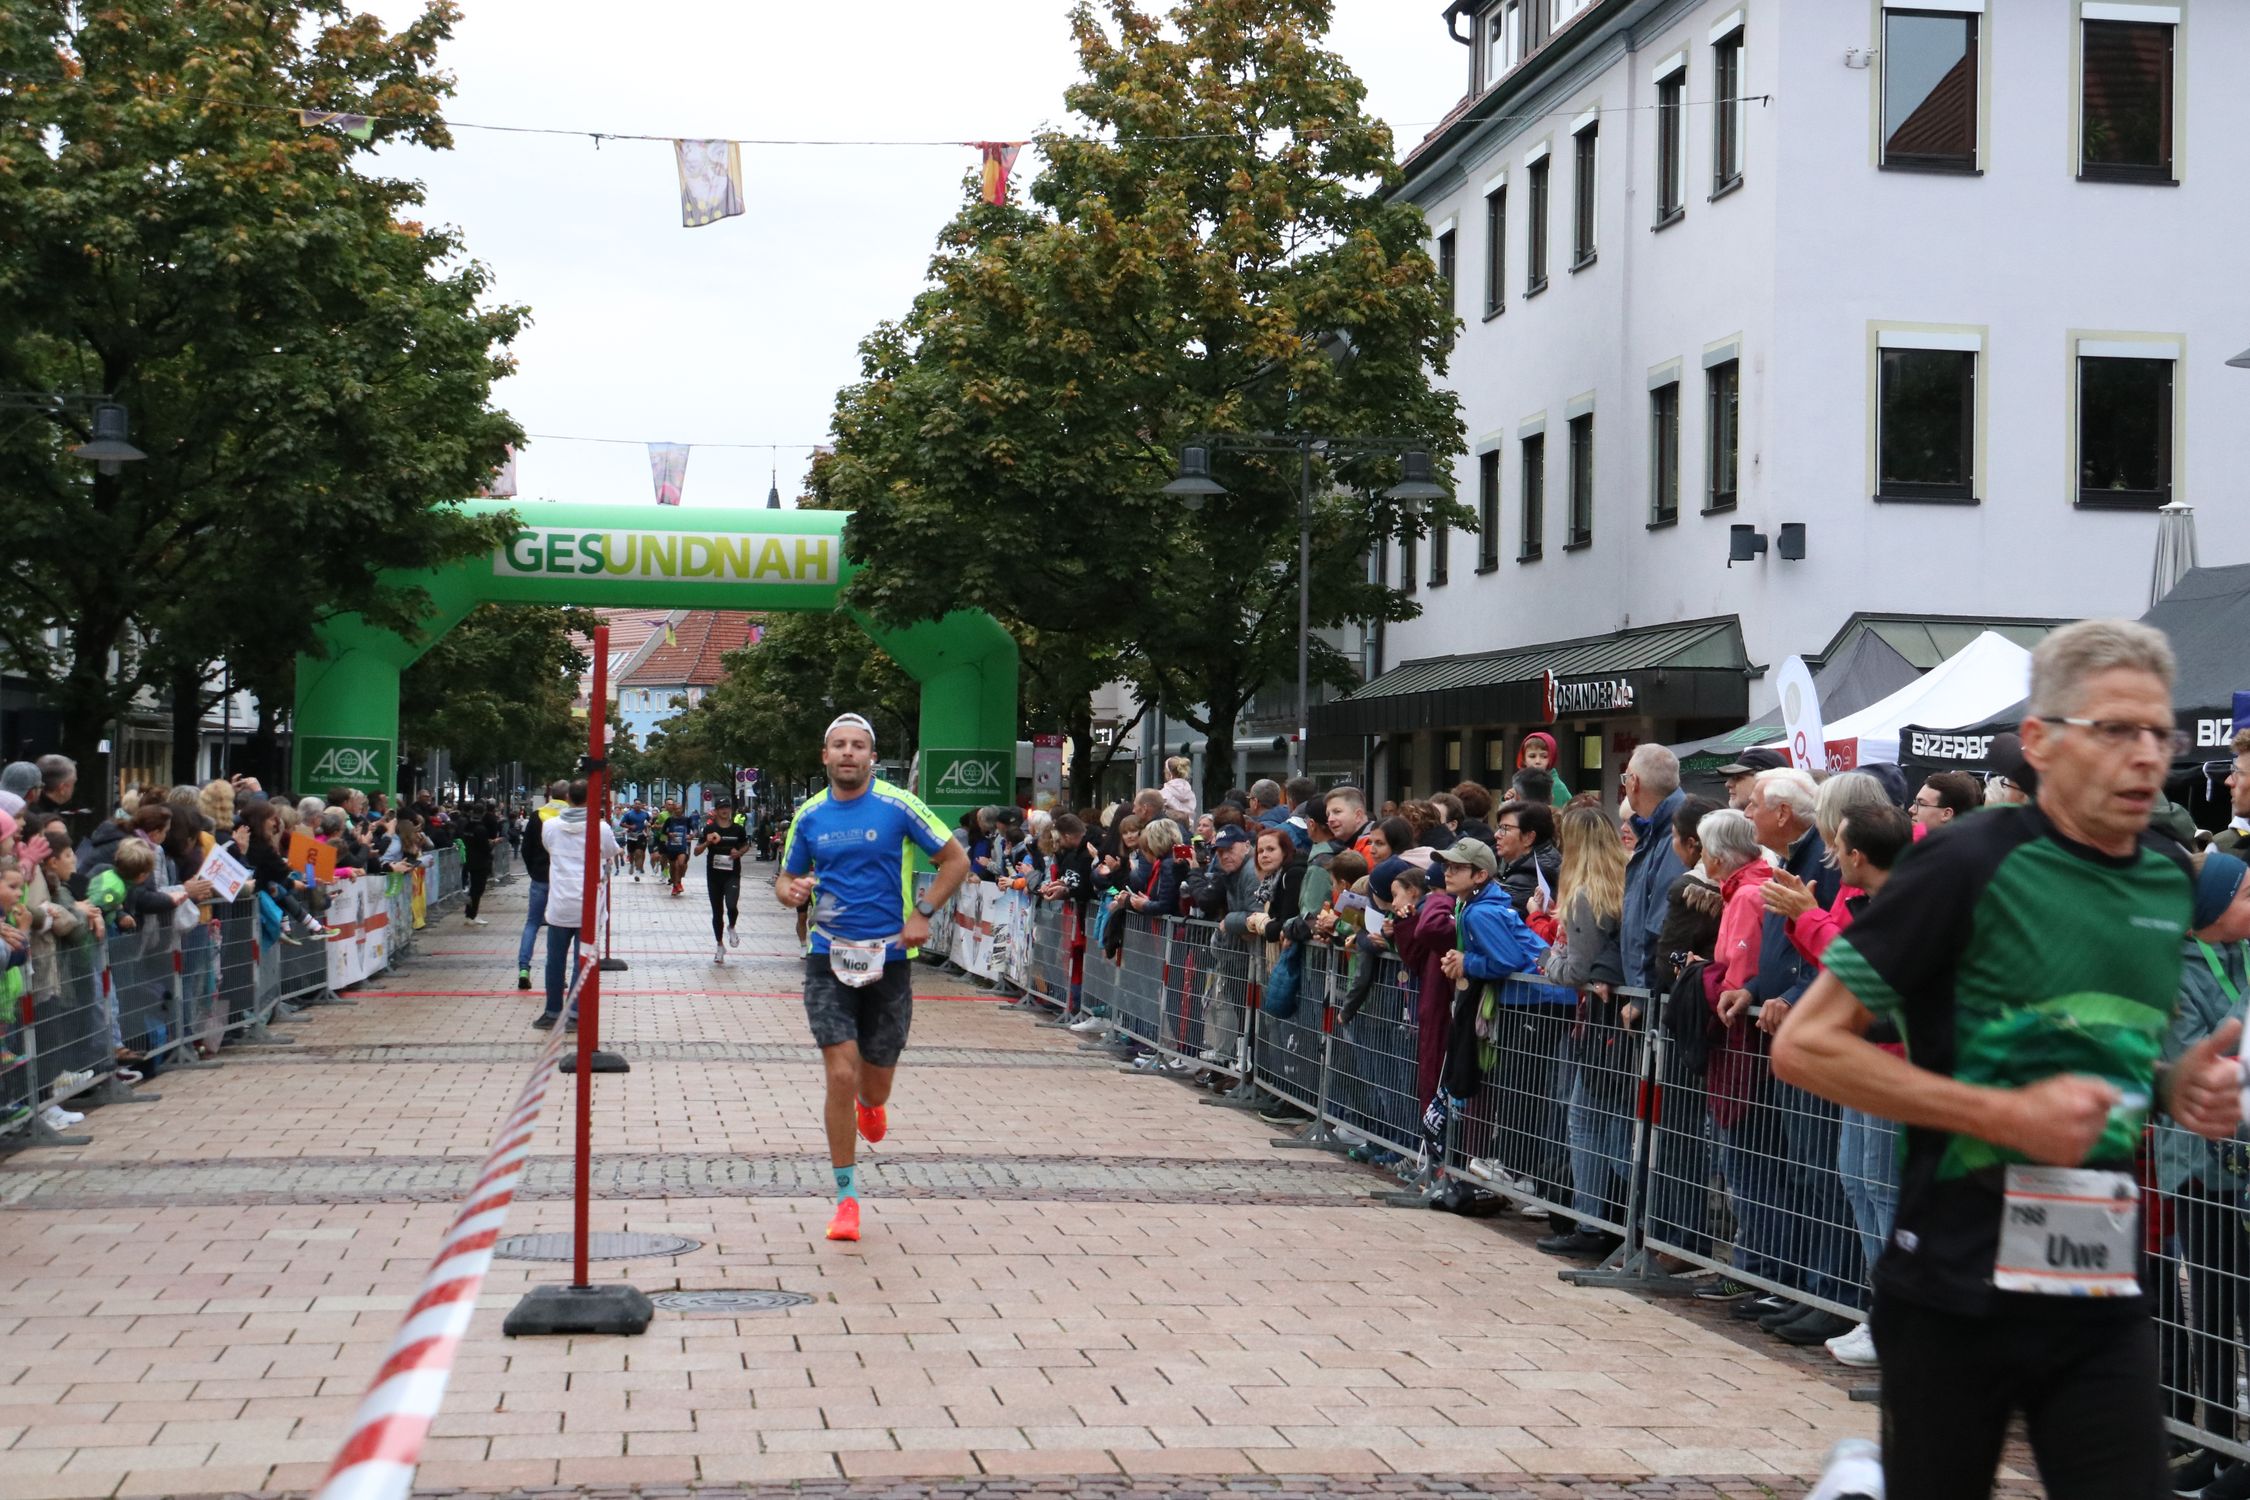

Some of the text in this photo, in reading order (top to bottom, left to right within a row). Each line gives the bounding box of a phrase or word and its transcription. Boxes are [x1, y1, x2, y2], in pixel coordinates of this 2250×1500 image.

[505, 531, 829, 580] GESUNDNAH
[311, 747, 380, 777] AOK
[937, 759, 1001, 787] AOK
[843, 958, 869, 972] Nico
[2046, 1232, 2109, 1270] Uwe
